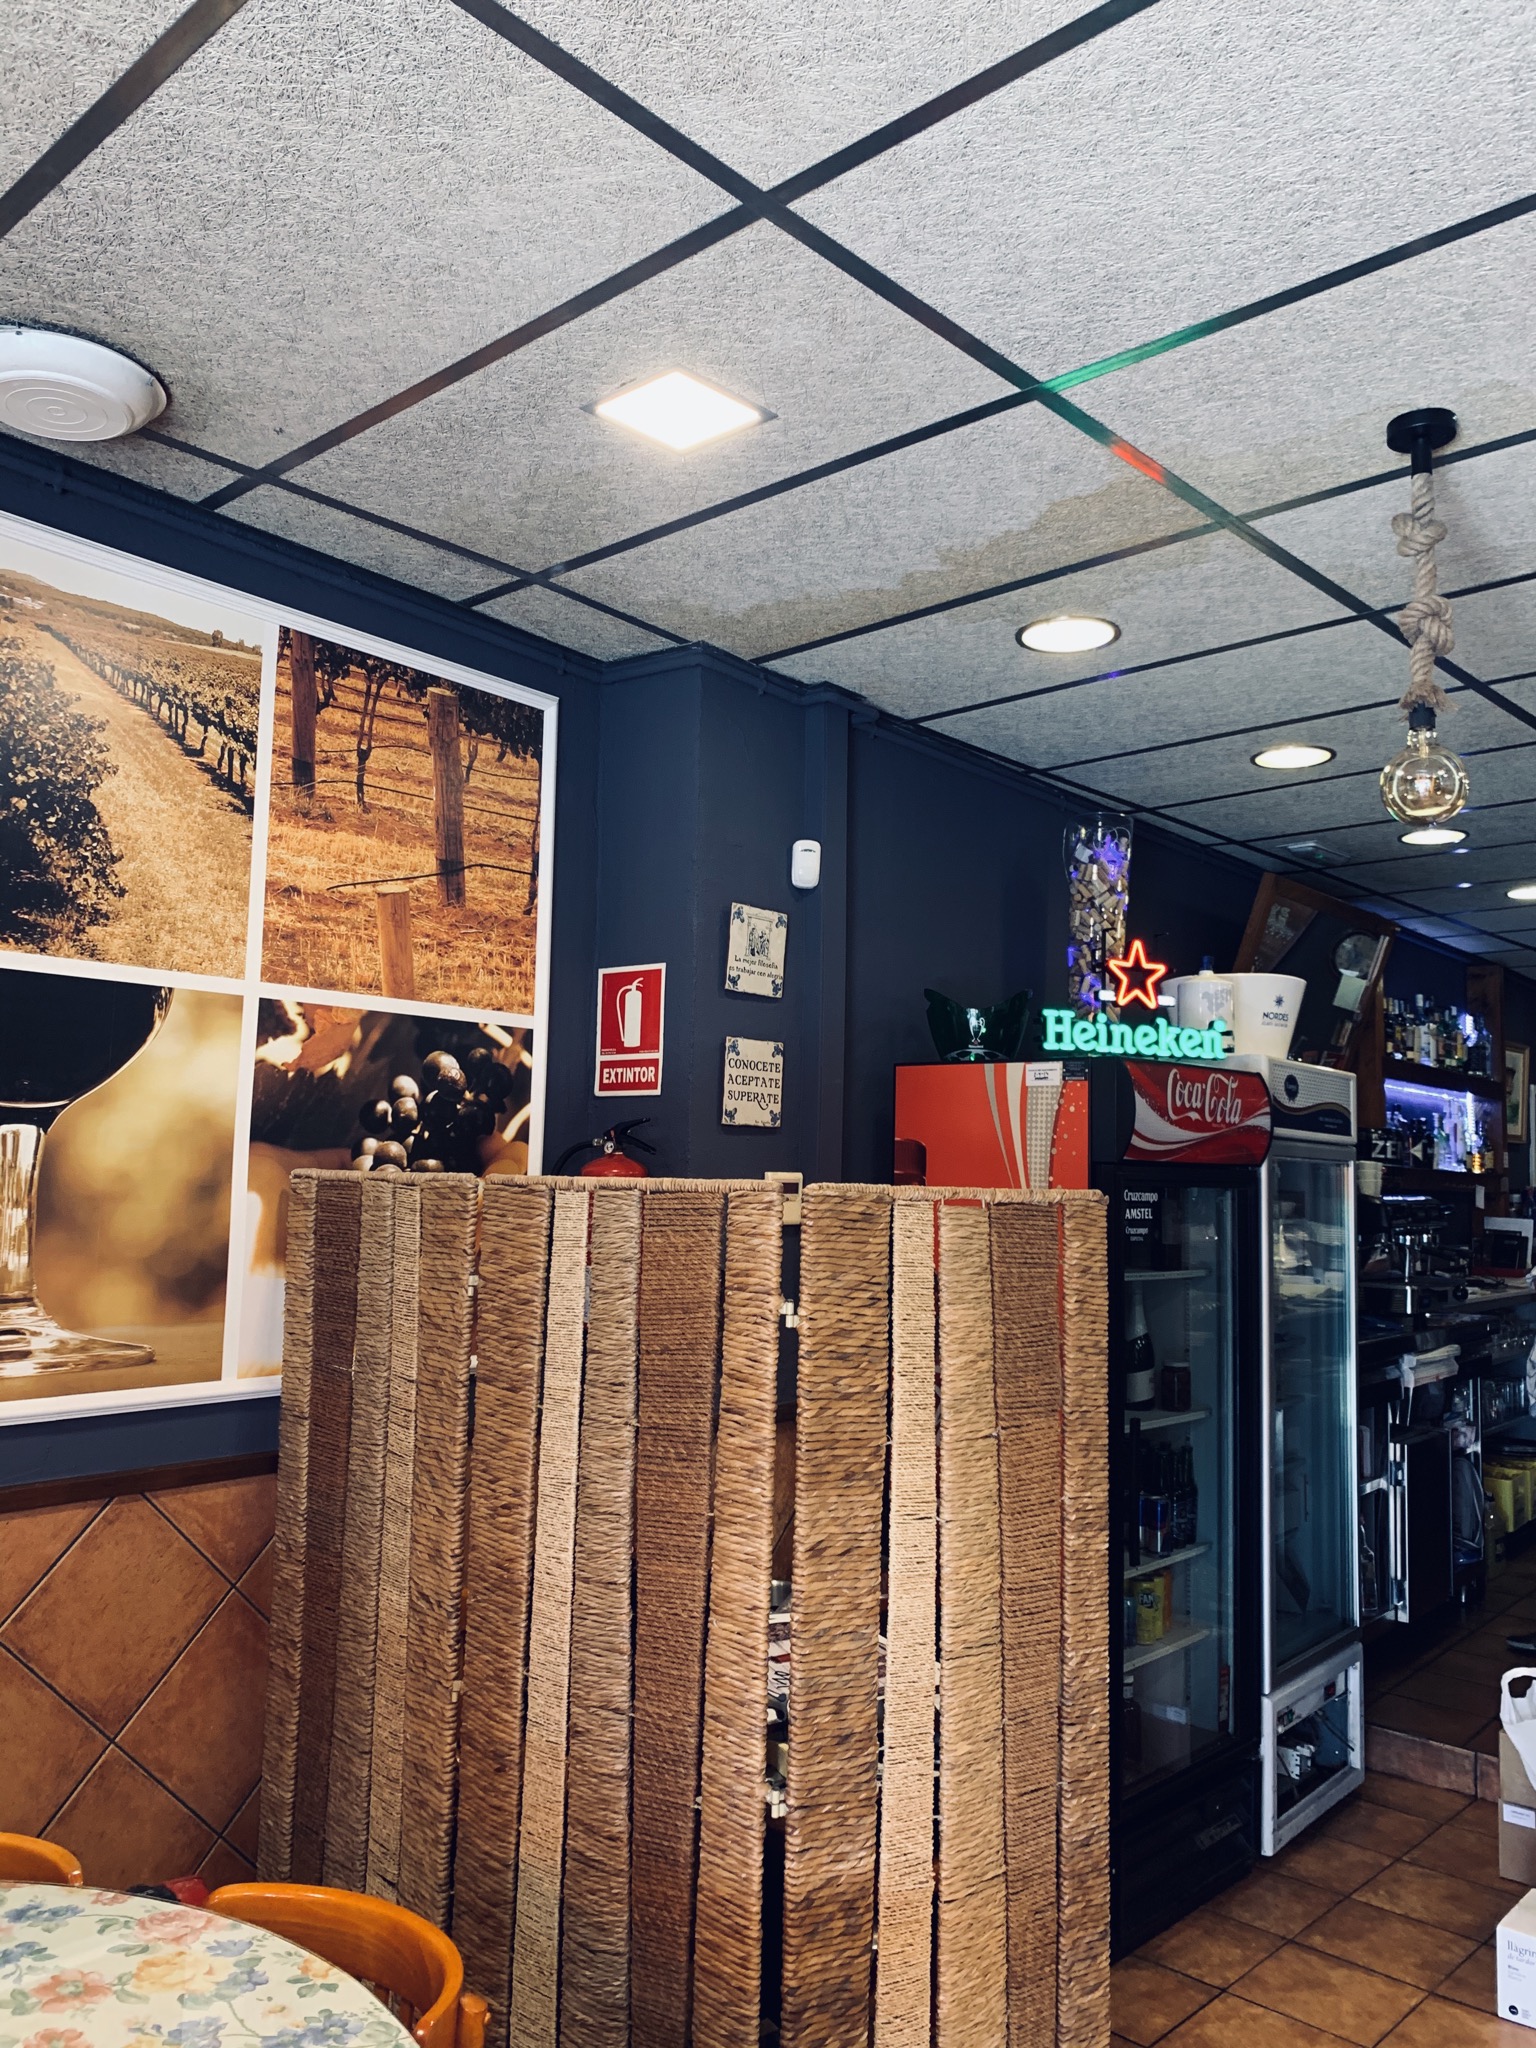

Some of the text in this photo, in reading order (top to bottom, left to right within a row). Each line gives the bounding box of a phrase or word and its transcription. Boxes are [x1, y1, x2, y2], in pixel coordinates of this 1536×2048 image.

[1041, 1009, 1227, 1060] Heineken
[728, 1058, 781, 1073] CONOCETE
[602, 1066, 655, 1084] EXTINTOR
[727, 1073, 780, 1089] ACEPTATE
[727, 1089, 780, 1111] SUPERATE
[1123, 1189, 1159, 1204] Cruzcampo
[1125, 1208, 1153, 1219] AMSTEL
